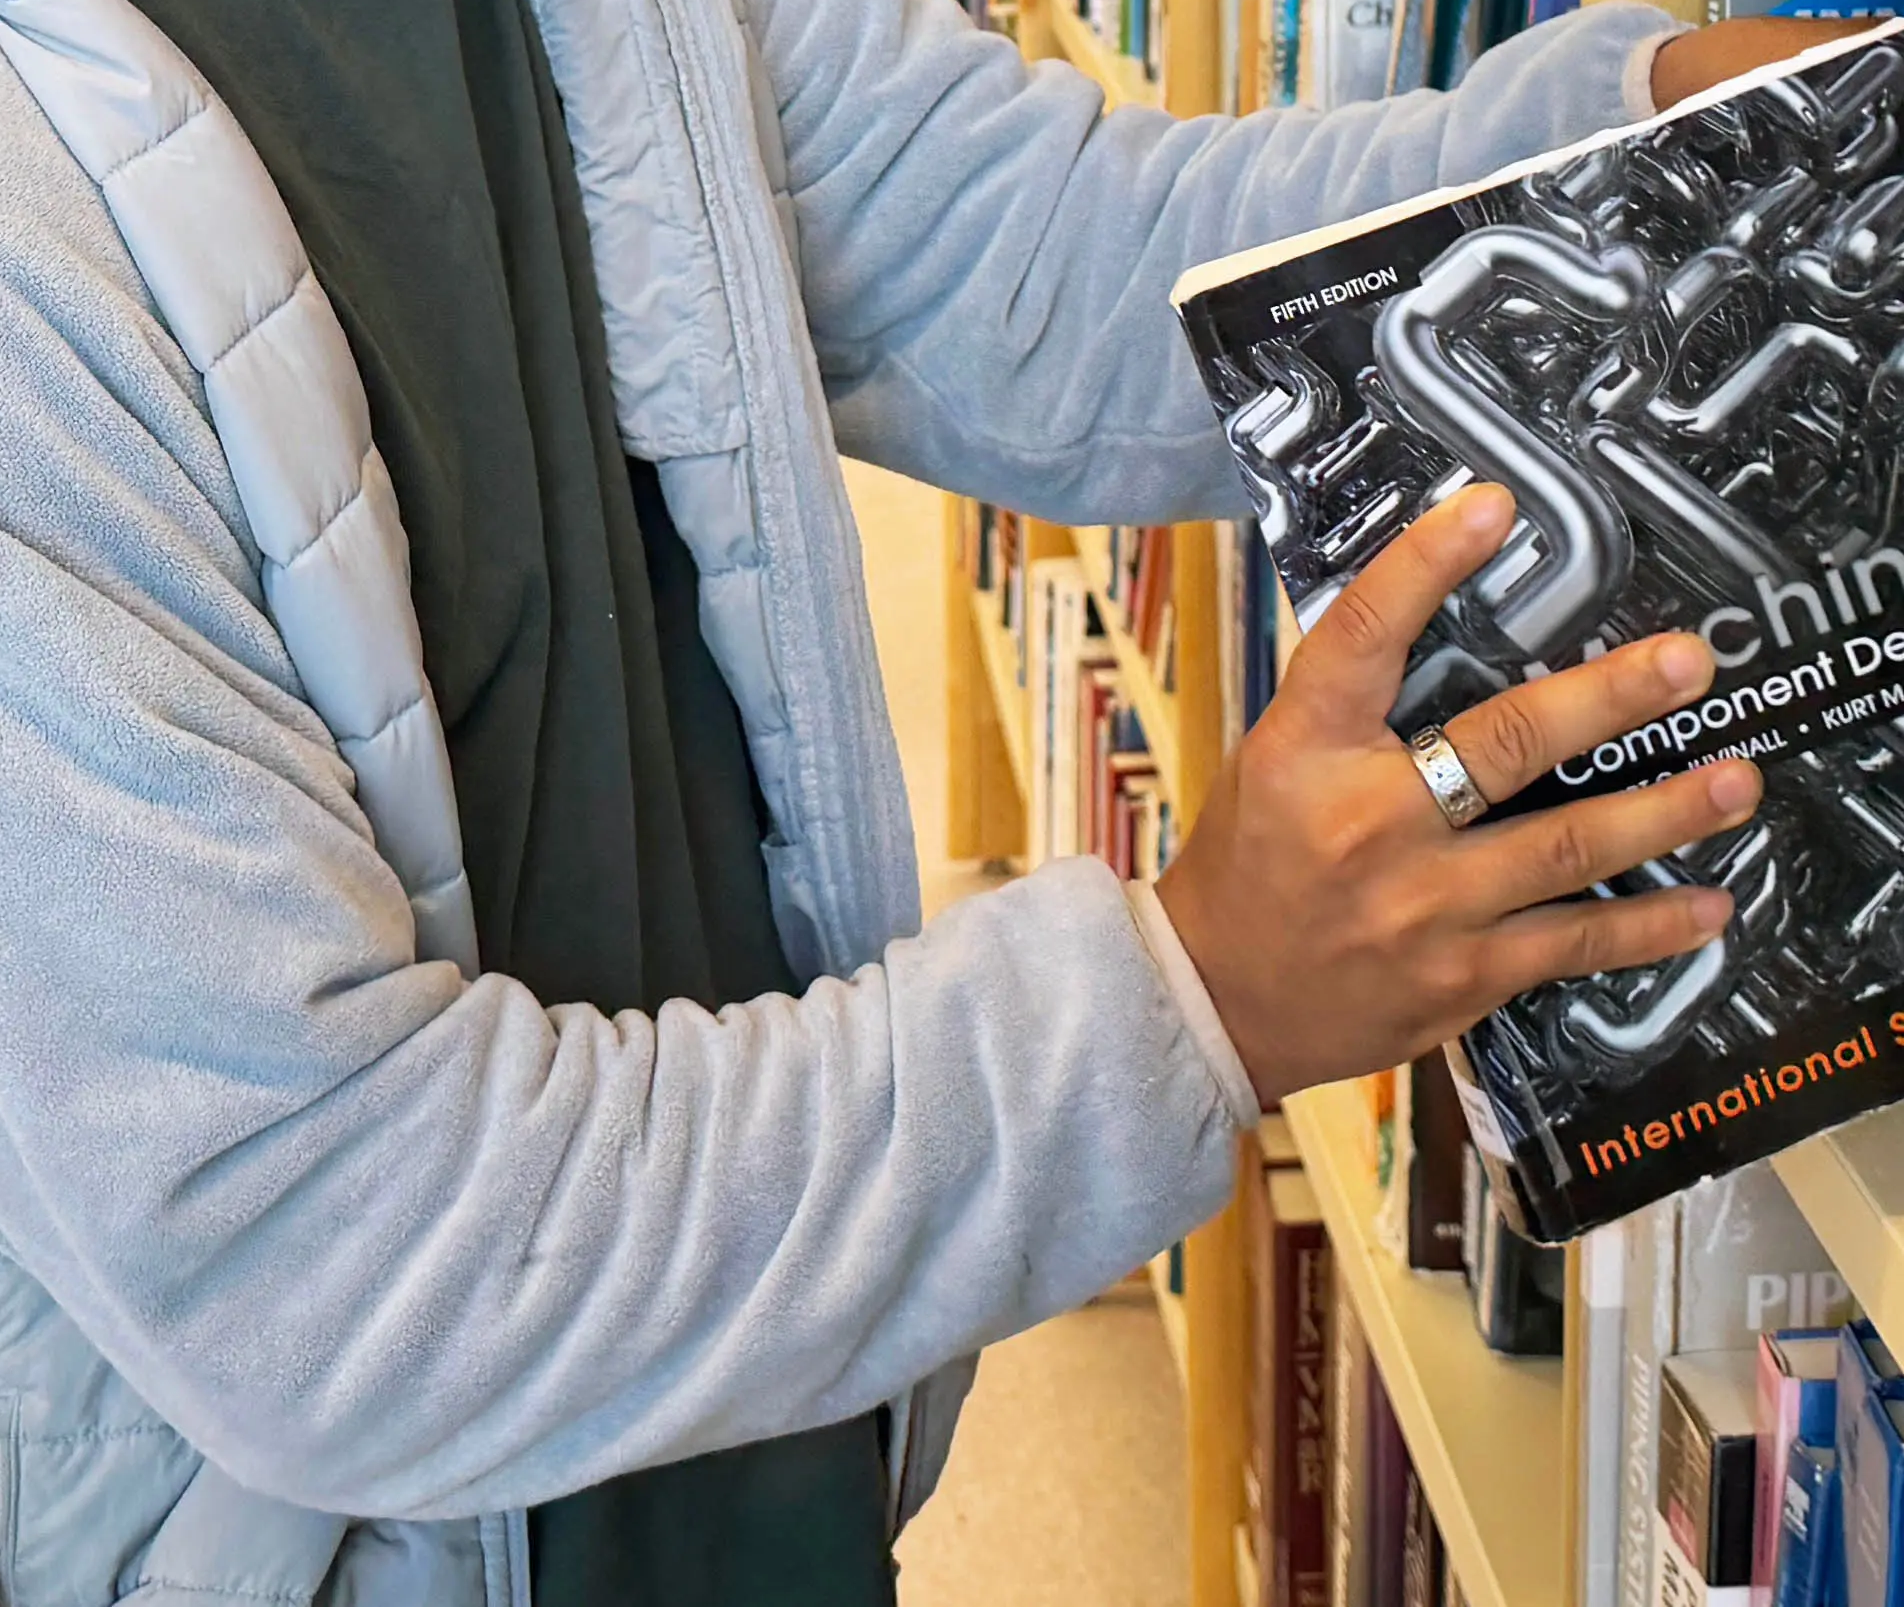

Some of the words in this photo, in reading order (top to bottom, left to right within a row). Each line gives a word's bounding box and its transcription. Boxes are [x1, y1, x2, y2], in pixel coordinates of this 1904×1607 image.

[1269, 282, 1319, 325] FIFTH
[1320, 265, 1400, 315] EDITION
[1554, 654, 1836, 788] Component
[1820, 696, 1878, 732] KURT
[1581, 1022, 1879, 1180] International
